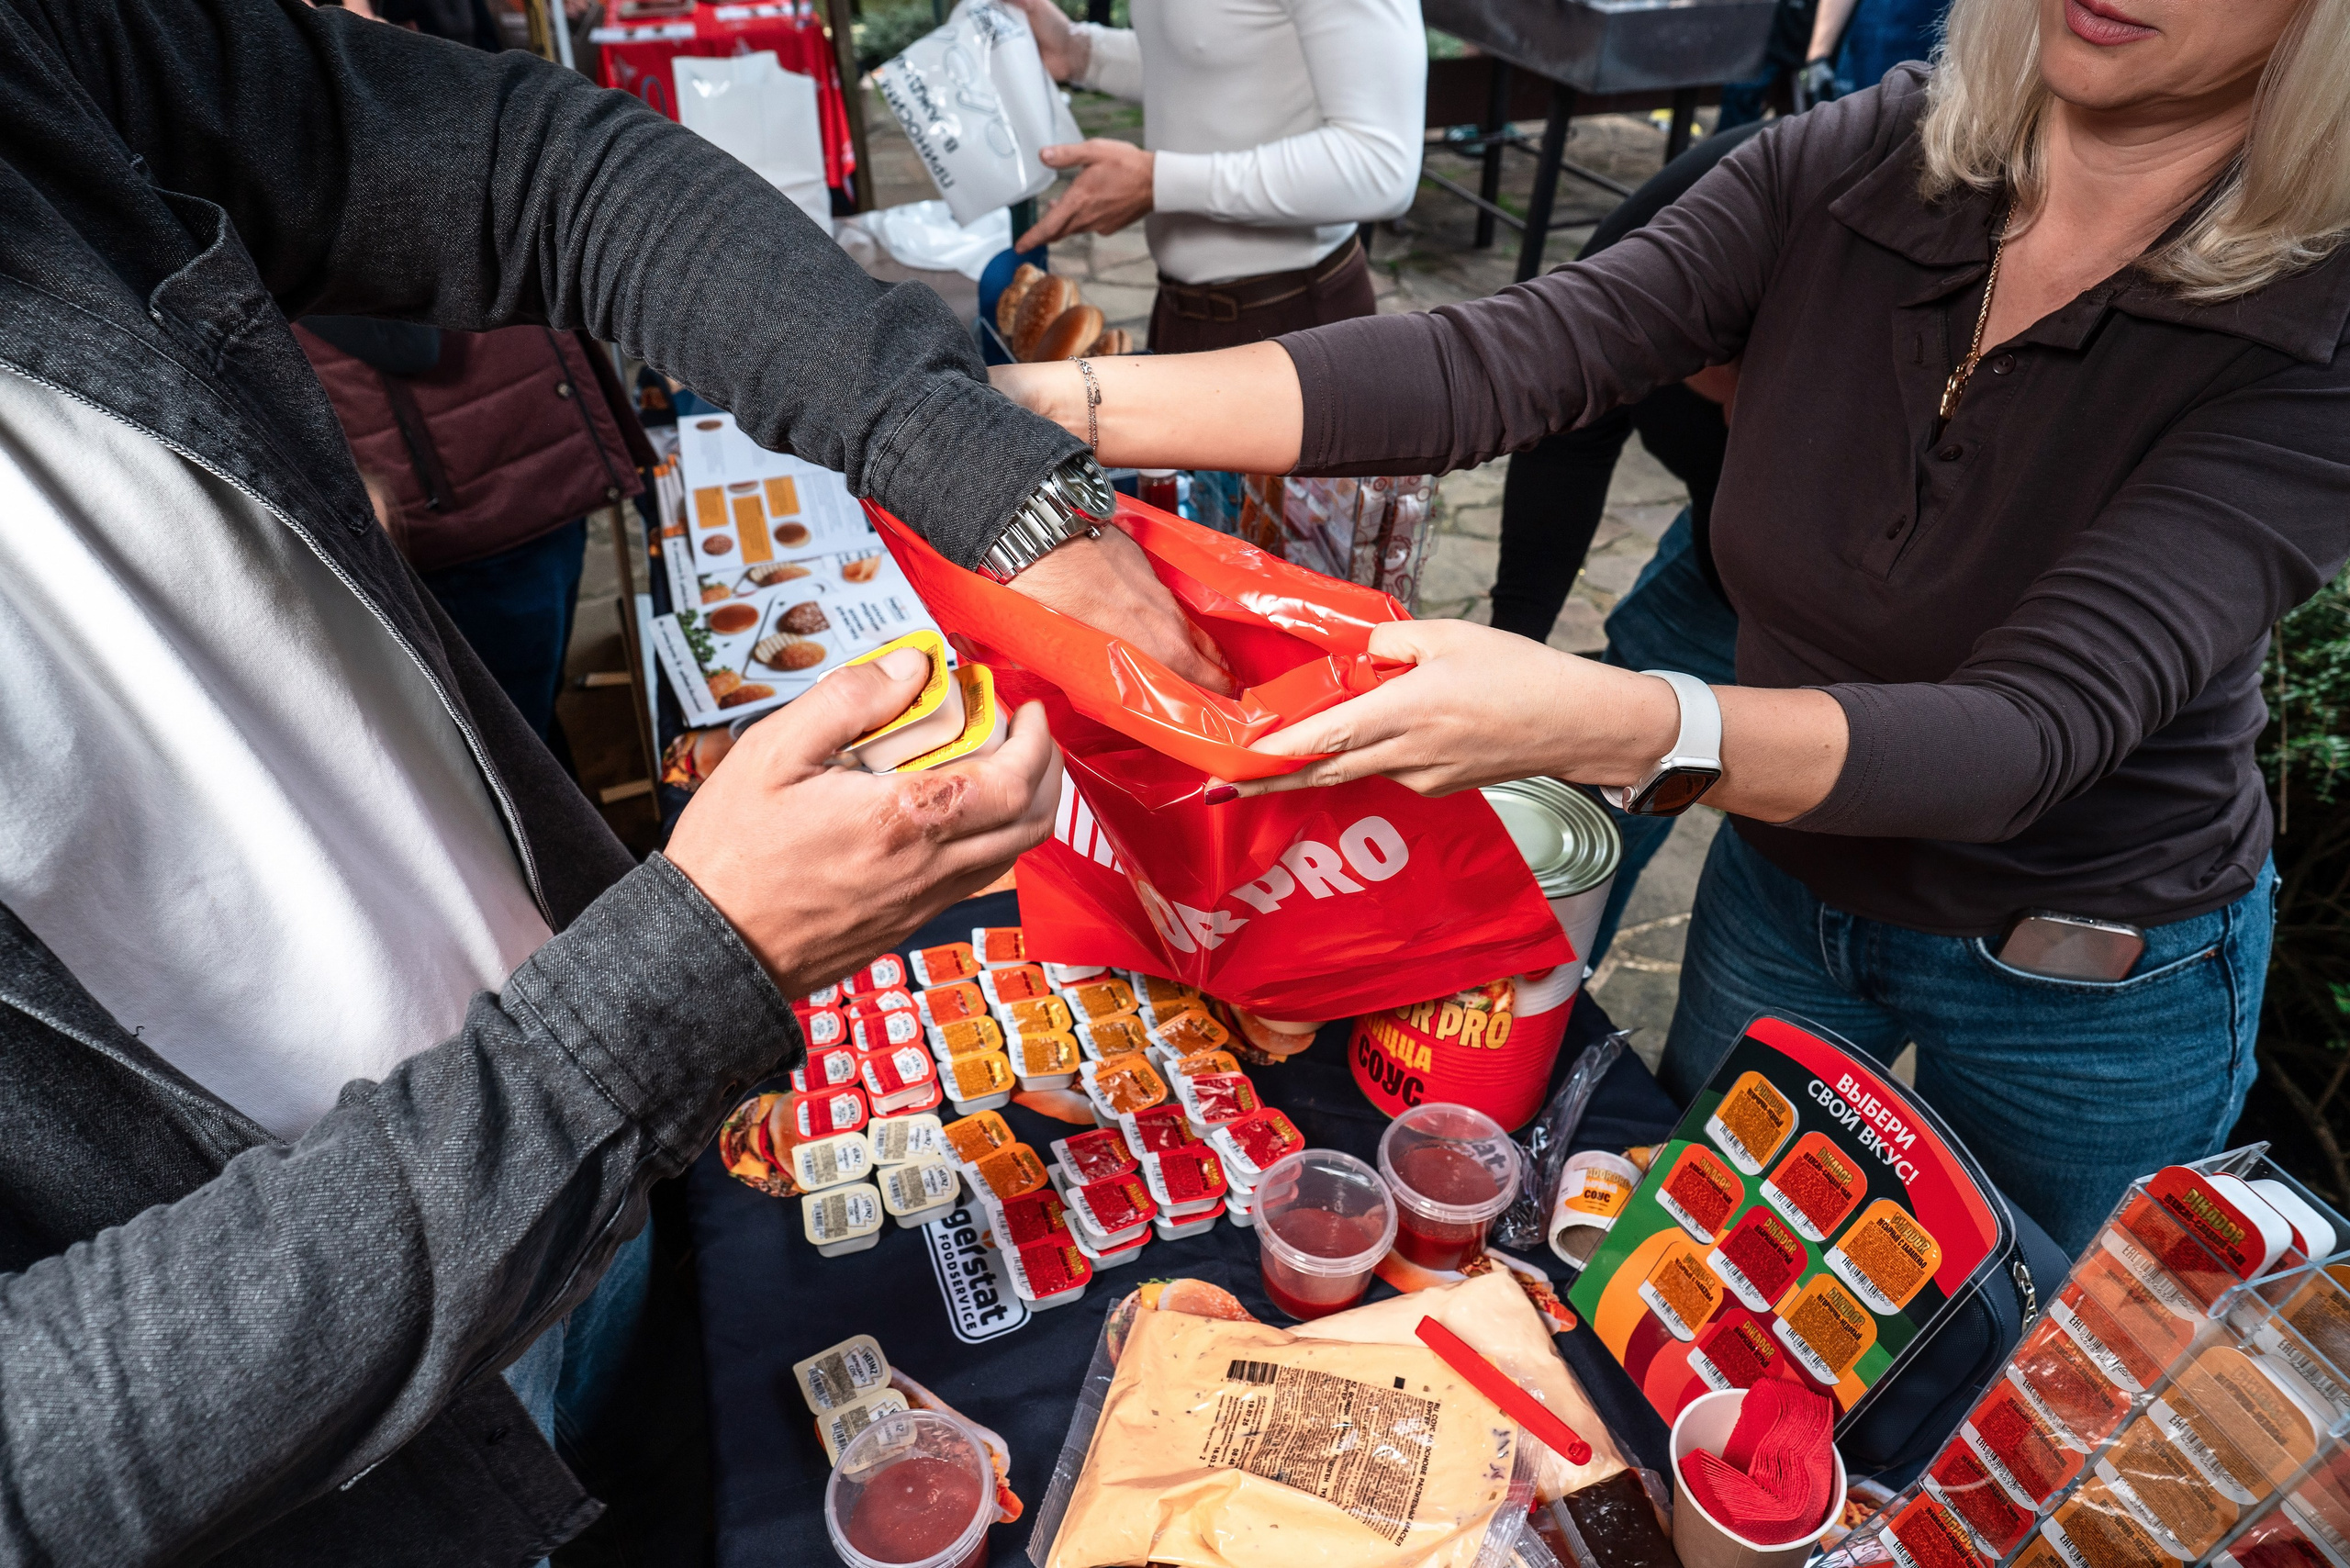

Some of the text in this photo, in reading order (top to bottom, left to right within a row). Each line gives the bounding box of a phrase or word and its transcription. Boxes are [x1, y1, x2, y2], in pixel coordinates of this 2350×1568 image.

[881, 77, 956, 190] ПРИНОСИМ
[1230, 815, 1409, 914] PRO
[1435, 1002, 1514, 1050] PRO
[1358, 1034, 1425, 1107] СОУС
[847, 1102, 856, 1121] HEINZ
[1754, 1080, 1786, 1115] PIKADOR
[1836, 1073, 1917, 1150] ВЫБЕРИ
[1807, 1080, 1919, 1185] СВОЙ ВКУС!
[938, 1168, 948, 1187] HEINZ
[1700, 1156, 1733, 1193] PIKADOR
[1817, 1147, 1853, 1186] PIKADOR
[1583, 1189, 1612, 1204] СОУС
[2182, 1188, 2245, 1247] PIKADOR
[1763, 1216, 1798, 1256] PIKADOR
[1880, 1221, 1902, 1243] СЫРНЫЙ
[1901, 1243, 1928, 1270] ХАЛАПЕНЬО
[1891, 1211, 1931, 1255] PIKADOR
[938, 1233, 977, 1330] FOODSERVICE
[940, 1208, 1008, 1326] gerstat
[1683, 1252, 1716, 1290] PIKADOR
[1818, 1294, 1863, 1342] ГОРЧИЧНО-МЕДОВЫЙ
[1825, 1287, 1865, 1329] PIKADOR
[2069, 1315, 2086, 1332] EAC
[1741, 1320, 1775, 1359] PIKADOR
[862, 1351, 878, 1375] HEINZ
[1429, 1413, 1438, 1432] СОУС
[1419, 1445, 1432, 1476] ОСНОВЕ
[1404, 1476, 1426, 1520] РАСТИТЕЛЬНЫХ
[1394, 1520, 1411, 1547] МАСЕЛ
[1929, 1511, 1968, 1562] КИСЛО-СЛАДКИЙ
